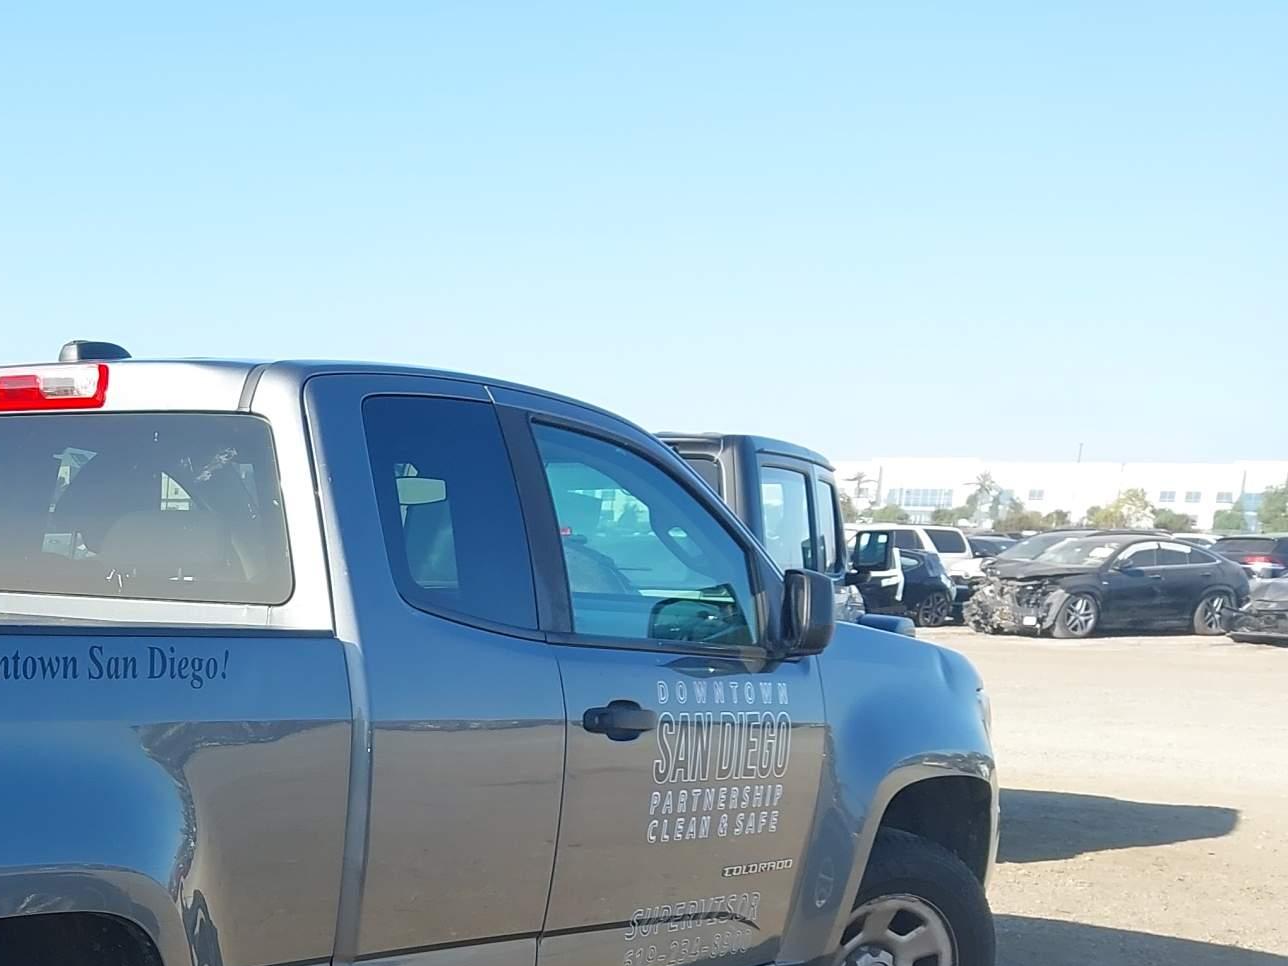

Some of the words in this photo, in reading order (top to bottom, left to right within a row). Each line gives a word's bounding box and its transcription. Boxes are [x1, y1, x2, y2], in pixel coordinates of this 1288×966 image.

[87, 645, 139, 681] San
[147, 646, 230, 689] Diego!
[656, 680, 789, 705] DOWNTOWN
[653, 711, 712, 784] SAN
[715, 711, 792, 780] DIEGO
[649, 784, 783, 815] PARTNERSHIP
[647, 815, 711, 843] CLEAN
[717, 813, 728, 837] &
[733, 810, 779, 836] SAFE
[723, 858, 793, 877] COLORADO
[624, 891, 760, 940] SUPERVISOR
